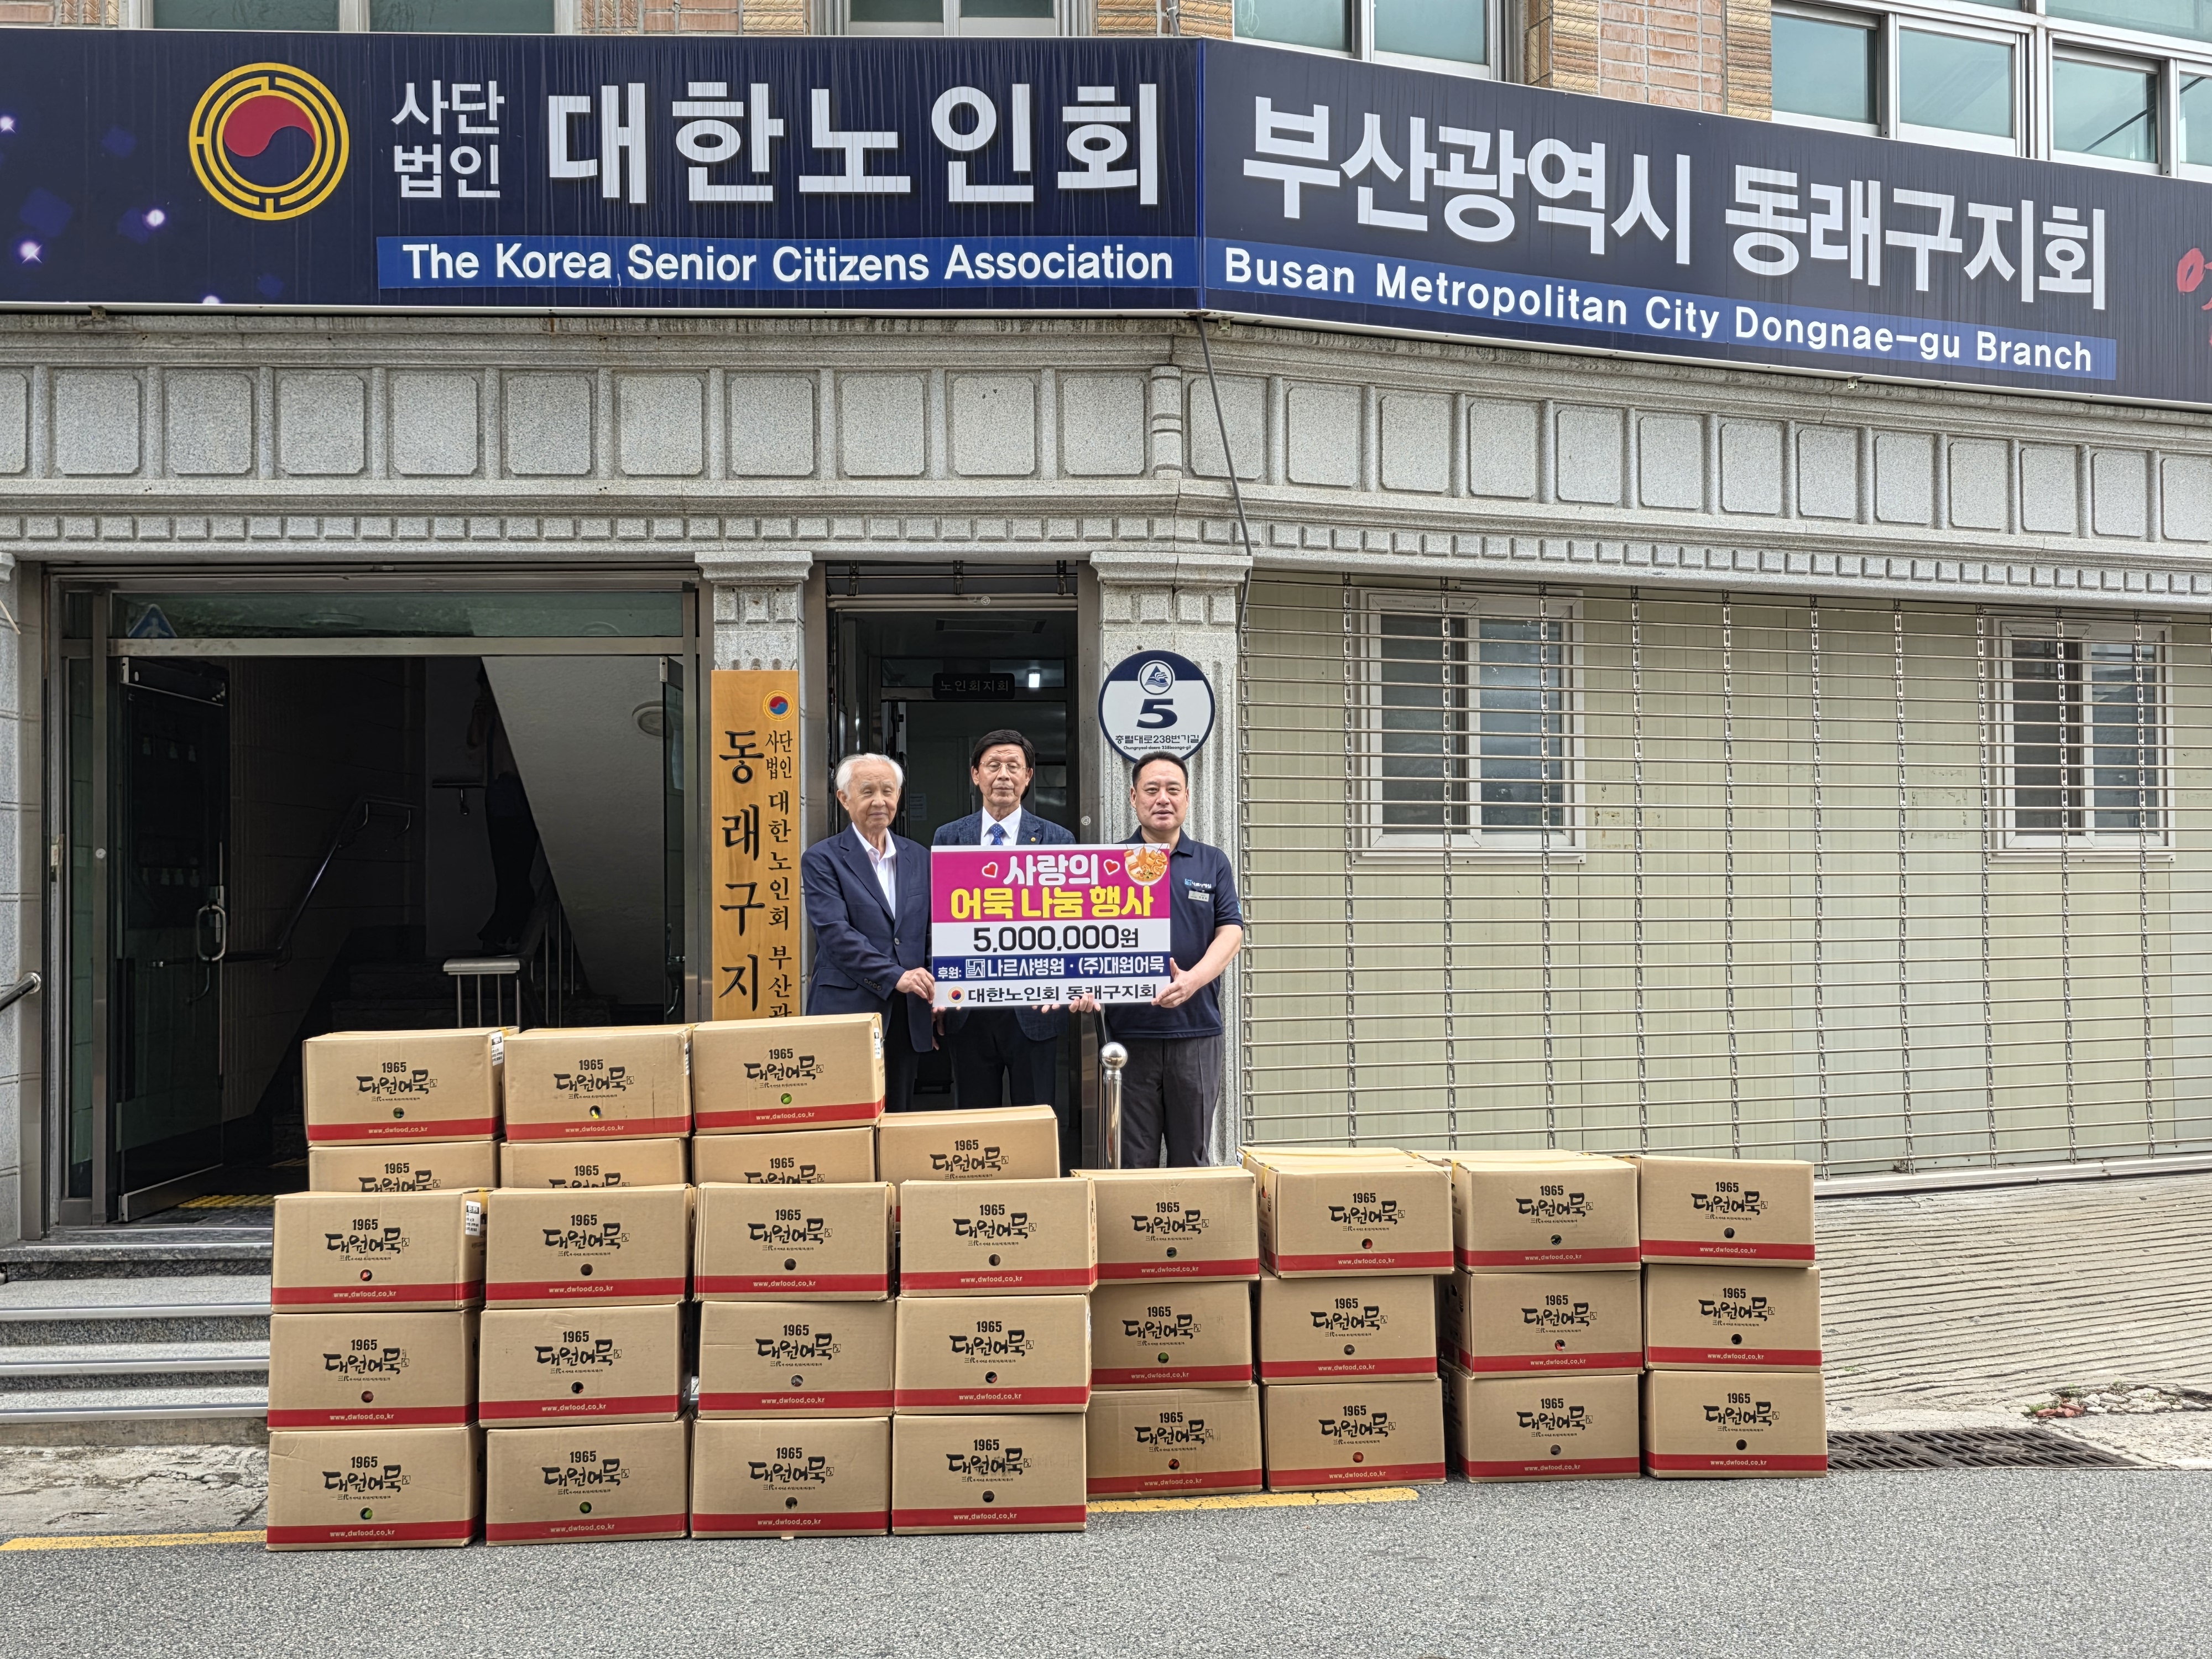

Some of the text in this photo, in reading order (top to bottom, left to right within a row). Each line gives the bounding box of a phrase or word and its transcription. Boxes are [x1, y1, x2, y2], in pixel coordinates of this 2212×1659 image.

[392, 80, 504, 134] 사단
[549, 82, 1157, 204] 대한노인회
[395, 144, 500, 197] 법인
[1243, 96, 2105, 310] 부산광역시 동래구지회
[403, 243, 1172, 281] The Korea Senior Citizens Association
[1225, 247, 1354, 294] Busan
[1376, 263, 1627, 325] Metropolitan
[1645, 296, 1719, 339] City
[1978, 331, 2092, 371] Branch
[940, 680, 1008, 692] 노인회지회
[1136, 698, 1177, 729] 5
[765, 730, 793, 753] 사단
[1115, 734, 1199, 744] 충렬대로238번가길
[766, 757, 792, 780] 법인
[768, 790, 792, 931] 대한노인회
[1003, 853, 1098, 886] 사랑의
[951, 885, 1154, 920] 어묵 나눔 행사
[973, 924, 1139, 953] 5,000,000원
[938, 956, 1165, 979] 후원: 나르샤병원 (주)대원어묵
[968, 983, 1156, 1003] 대한노인회 동래구지회
[769, 1048, 793, 1059] 1965
[382, 1062, 406, 1073] 1965
[579, 1060, 603, 1070] 1965
[744, 1055, 817, 1081] 대원어묵
[356, 1069, 430, 1094] 대원어묵
[554, 1066, 627, 1092] 대원어묵
[756, 1112, 815, 1120] www.dwfood.co.kr
[955, 1140, 978, 1150] 1965
[385, 1163, 409, 1173] 1965
[770, 1157, 794, 1168] 1965
[930, 1146, 1002, 1172] 대원어묵
[575, 1165, 598, 1176] 1965
[1540, 1186, 1563, 1196] 1965
[1716, 1182, 1739, 1192] 1965
[1156, 1202, 1179, 1213] 1965
[1353, 1193, 1376, 1203] 1965
[1516, 1192, 1587, 1217] 대원어묵
[1691, 1188, 1761, 1215] 대원어묵
[571, 1214, 597, 1225] 1965
[775, 1209, 801, 1220] 1965
[980, 1204, 1004, 1215] 1965
[1328, 1199, 1399, 1224] 대원어묵
[353, 1219, 378, 1230] 1965
[748, 1217, 825, 1244] 대원어묵
[953, 1212, 1029, 1239] 대원어묵
[1131, 1209, 1202, 1234] 대원어묵
[325, 1227, 402, 1254] 대원어묵
[542, 1222, 622, 1249] 대원어묵
[960, 1275, 1022, 1284] www.dwfood.co.kr
[333, 1290, 397, 1298] www.dwfood.co.kr
[1335, 1298, 1358, 1308] 1965
[1546, 1295, 1568, 1305] 1965
[1723, 1288, 1746, 1298] 1965
[1147, 1306, 1171, 1317] 1965
[1311, 1305, 1381, 1330] 대원어묵
[1521, 1302, 1590, 1327] 대원어묵
[1698, 1295, 1768, 1321] 대원어묵
[784, 1324, 808, 1335] 1965
[977, 1321, 1001, 1332] 1965
[1122, 1313, 1194, 1339] 대원어묵
[351, 1339, 377, 1350] 1965
[563, 1331, 589, 1343] 1965
[755, 1332, 833, 1360] 대원어묵
[949, 1328, 1026, 1357] 대원어묵
[323, 1347, 402, 1374] 대원어묵
[535, 1339, 614, 1366] 대원어묵
[541, 1403, 607, 1412] www.dwfood.co.kr
[1541, 1399, 1563, 1408] 1965
[1728, 1393, 1750, 1404] 1965
[1160, 1412, 1183, 1423] 1965
[1343, 1405, 1366, 1416] 1965
[1516, 1405, 1586, 1430] 대원어묵
[1703, 1400, 1773, 1426] 대원어묵
[1134, 1419, 1206, 1446] 대원어묵
[1318, 1412, 1389, 1437] 대원어묵
[776, 1447, 802, 1459] 1965
[974, 1439, 999, 1451] 1965
[351, 1457, 377, 1468] 1965
[570, 1451, 596, 1463] 1965
[946, 1447, 1024, 1475] 대원어묵
[322, 1464, 403, 1493] 대원어묵
[542, 1459, 622, 1486] 대원어묵
[748, 1455, 827, 1484] 대원어묵
[1329, 1470, 1386, 1479] www.dwfood.co.kr
[1144, 1478, 1202, 1486] www.dwfood.co.kr
[953, 1512, 1018, 1520] www.dwfood.co.kr
[330, 1528, 395, 1537] www.dwfood.co.kr
[550, 1523, 615, 1532] www.dwfood.co.kr
